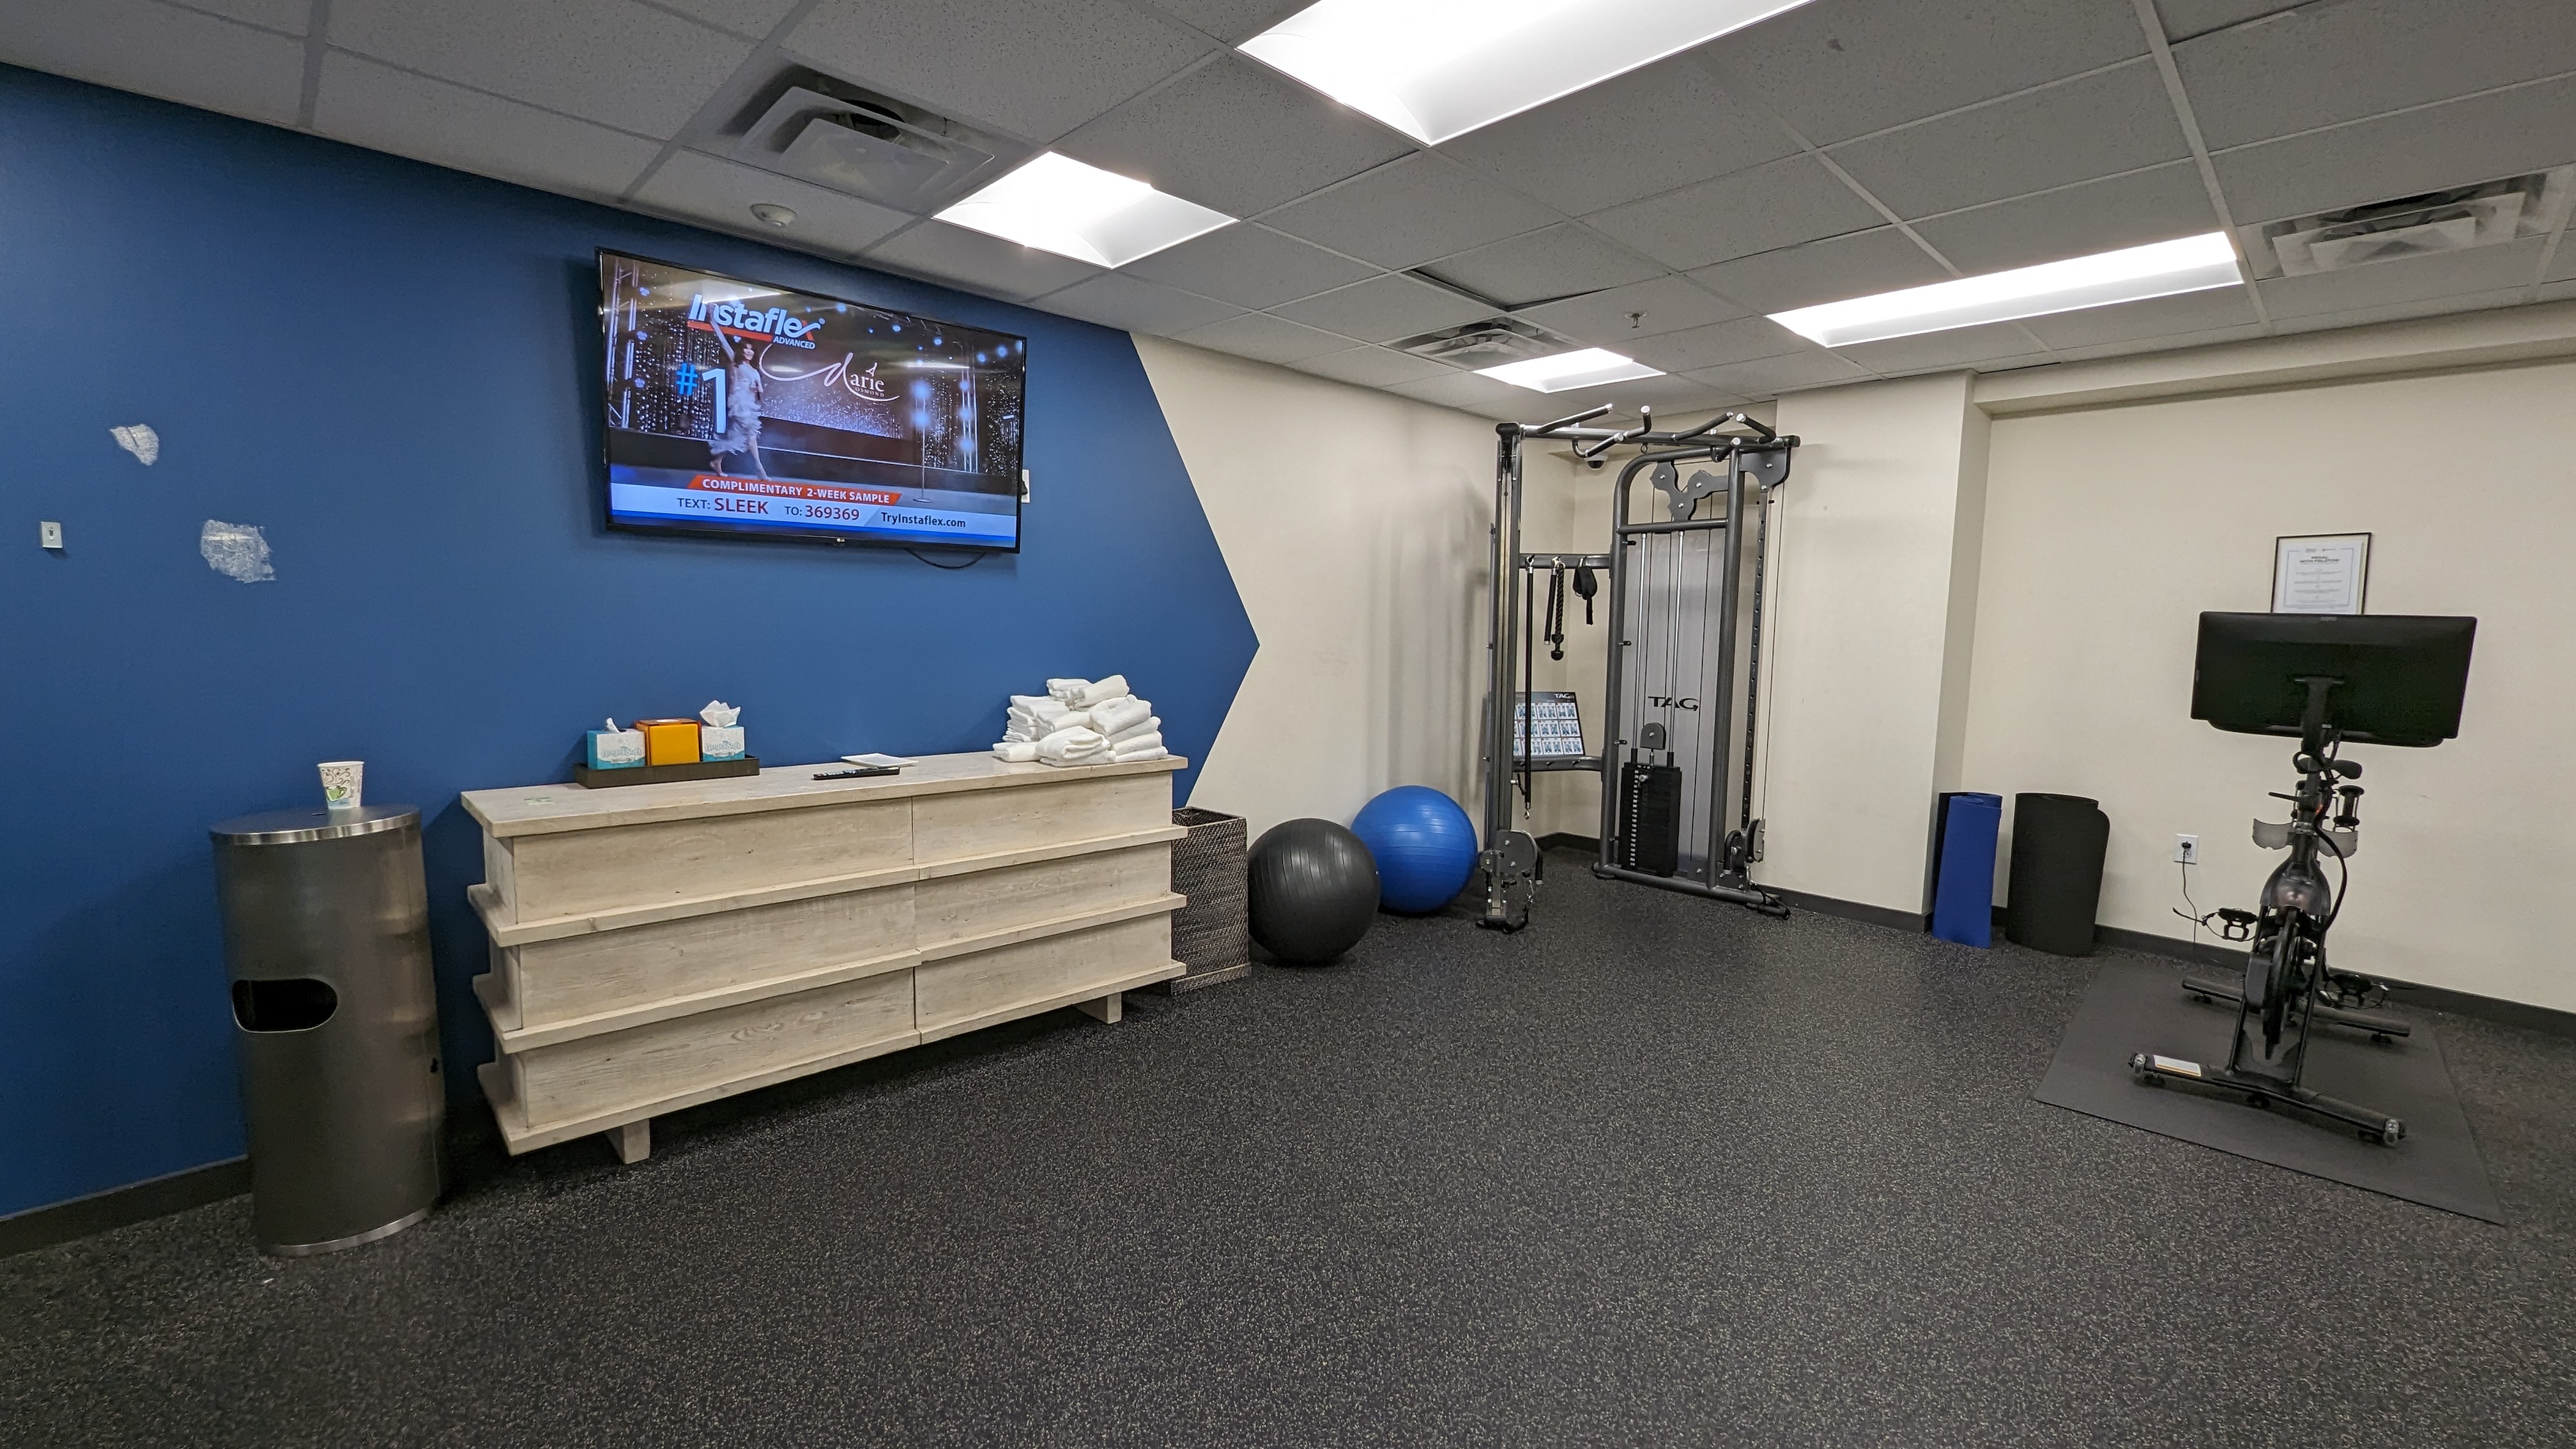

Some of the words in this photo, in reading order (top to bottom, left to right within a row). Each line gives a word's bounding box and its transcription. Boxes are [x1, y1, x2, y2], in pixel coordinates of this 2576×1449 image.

[688, 294, 821, 341] Instaflex
[773, 336, 816, 350] ADVANCED
[855, 387, 885, 397] OSMOND
[703, 479, 803, 496] COMPLIMENTARY
[806, 487, 847, 500] 2-WEEK
[848, 491, 890, 503] SAMPLE
[677, 498, 710, 509] TEXT:
[714, 497, 769, 514] SLEEK
[784, 505, 802, 516] TO:
[805, 505, 860, 521] 369369
[881, 512, 966, 528] TryInstaflex.com
[1648, 696, 1699, 712] TAG
